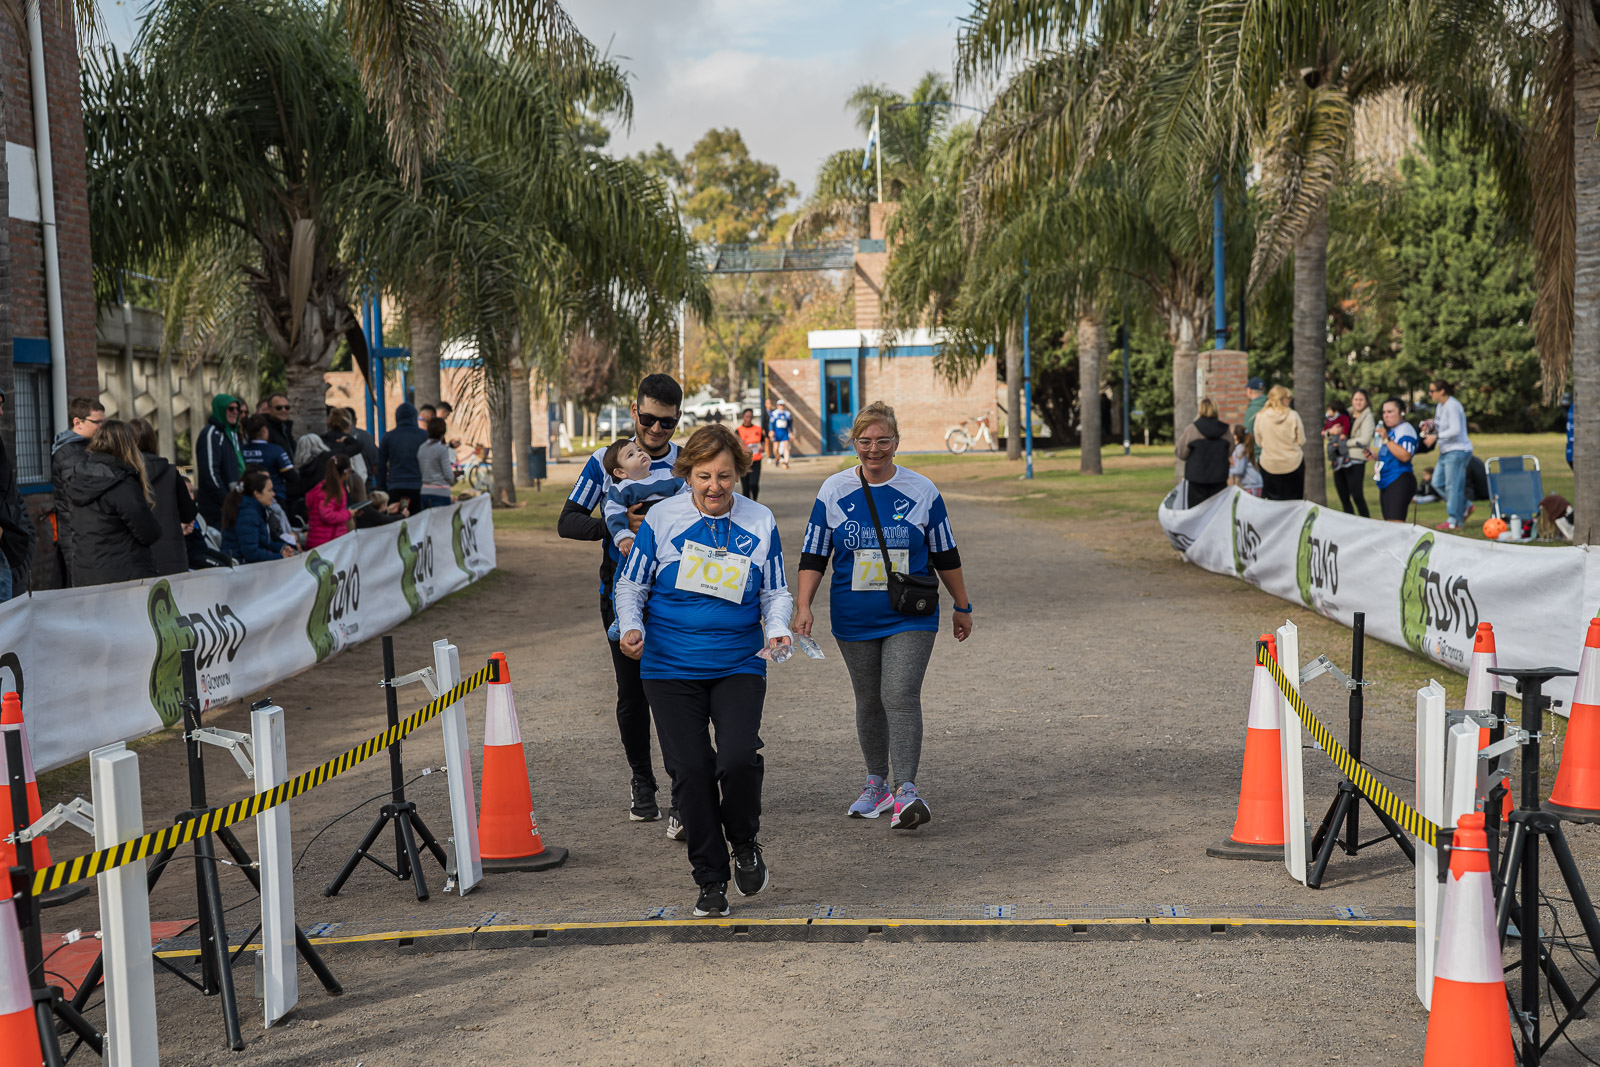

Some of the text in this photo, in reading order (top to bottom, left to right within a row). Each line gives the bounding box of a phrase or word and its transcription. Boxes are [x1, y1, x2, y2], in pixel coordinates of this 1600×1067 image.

[843, 520, 860, 550] 3
[861, 525, 910, 539] MAATÓN
[685, 555, 741, 591] 702
